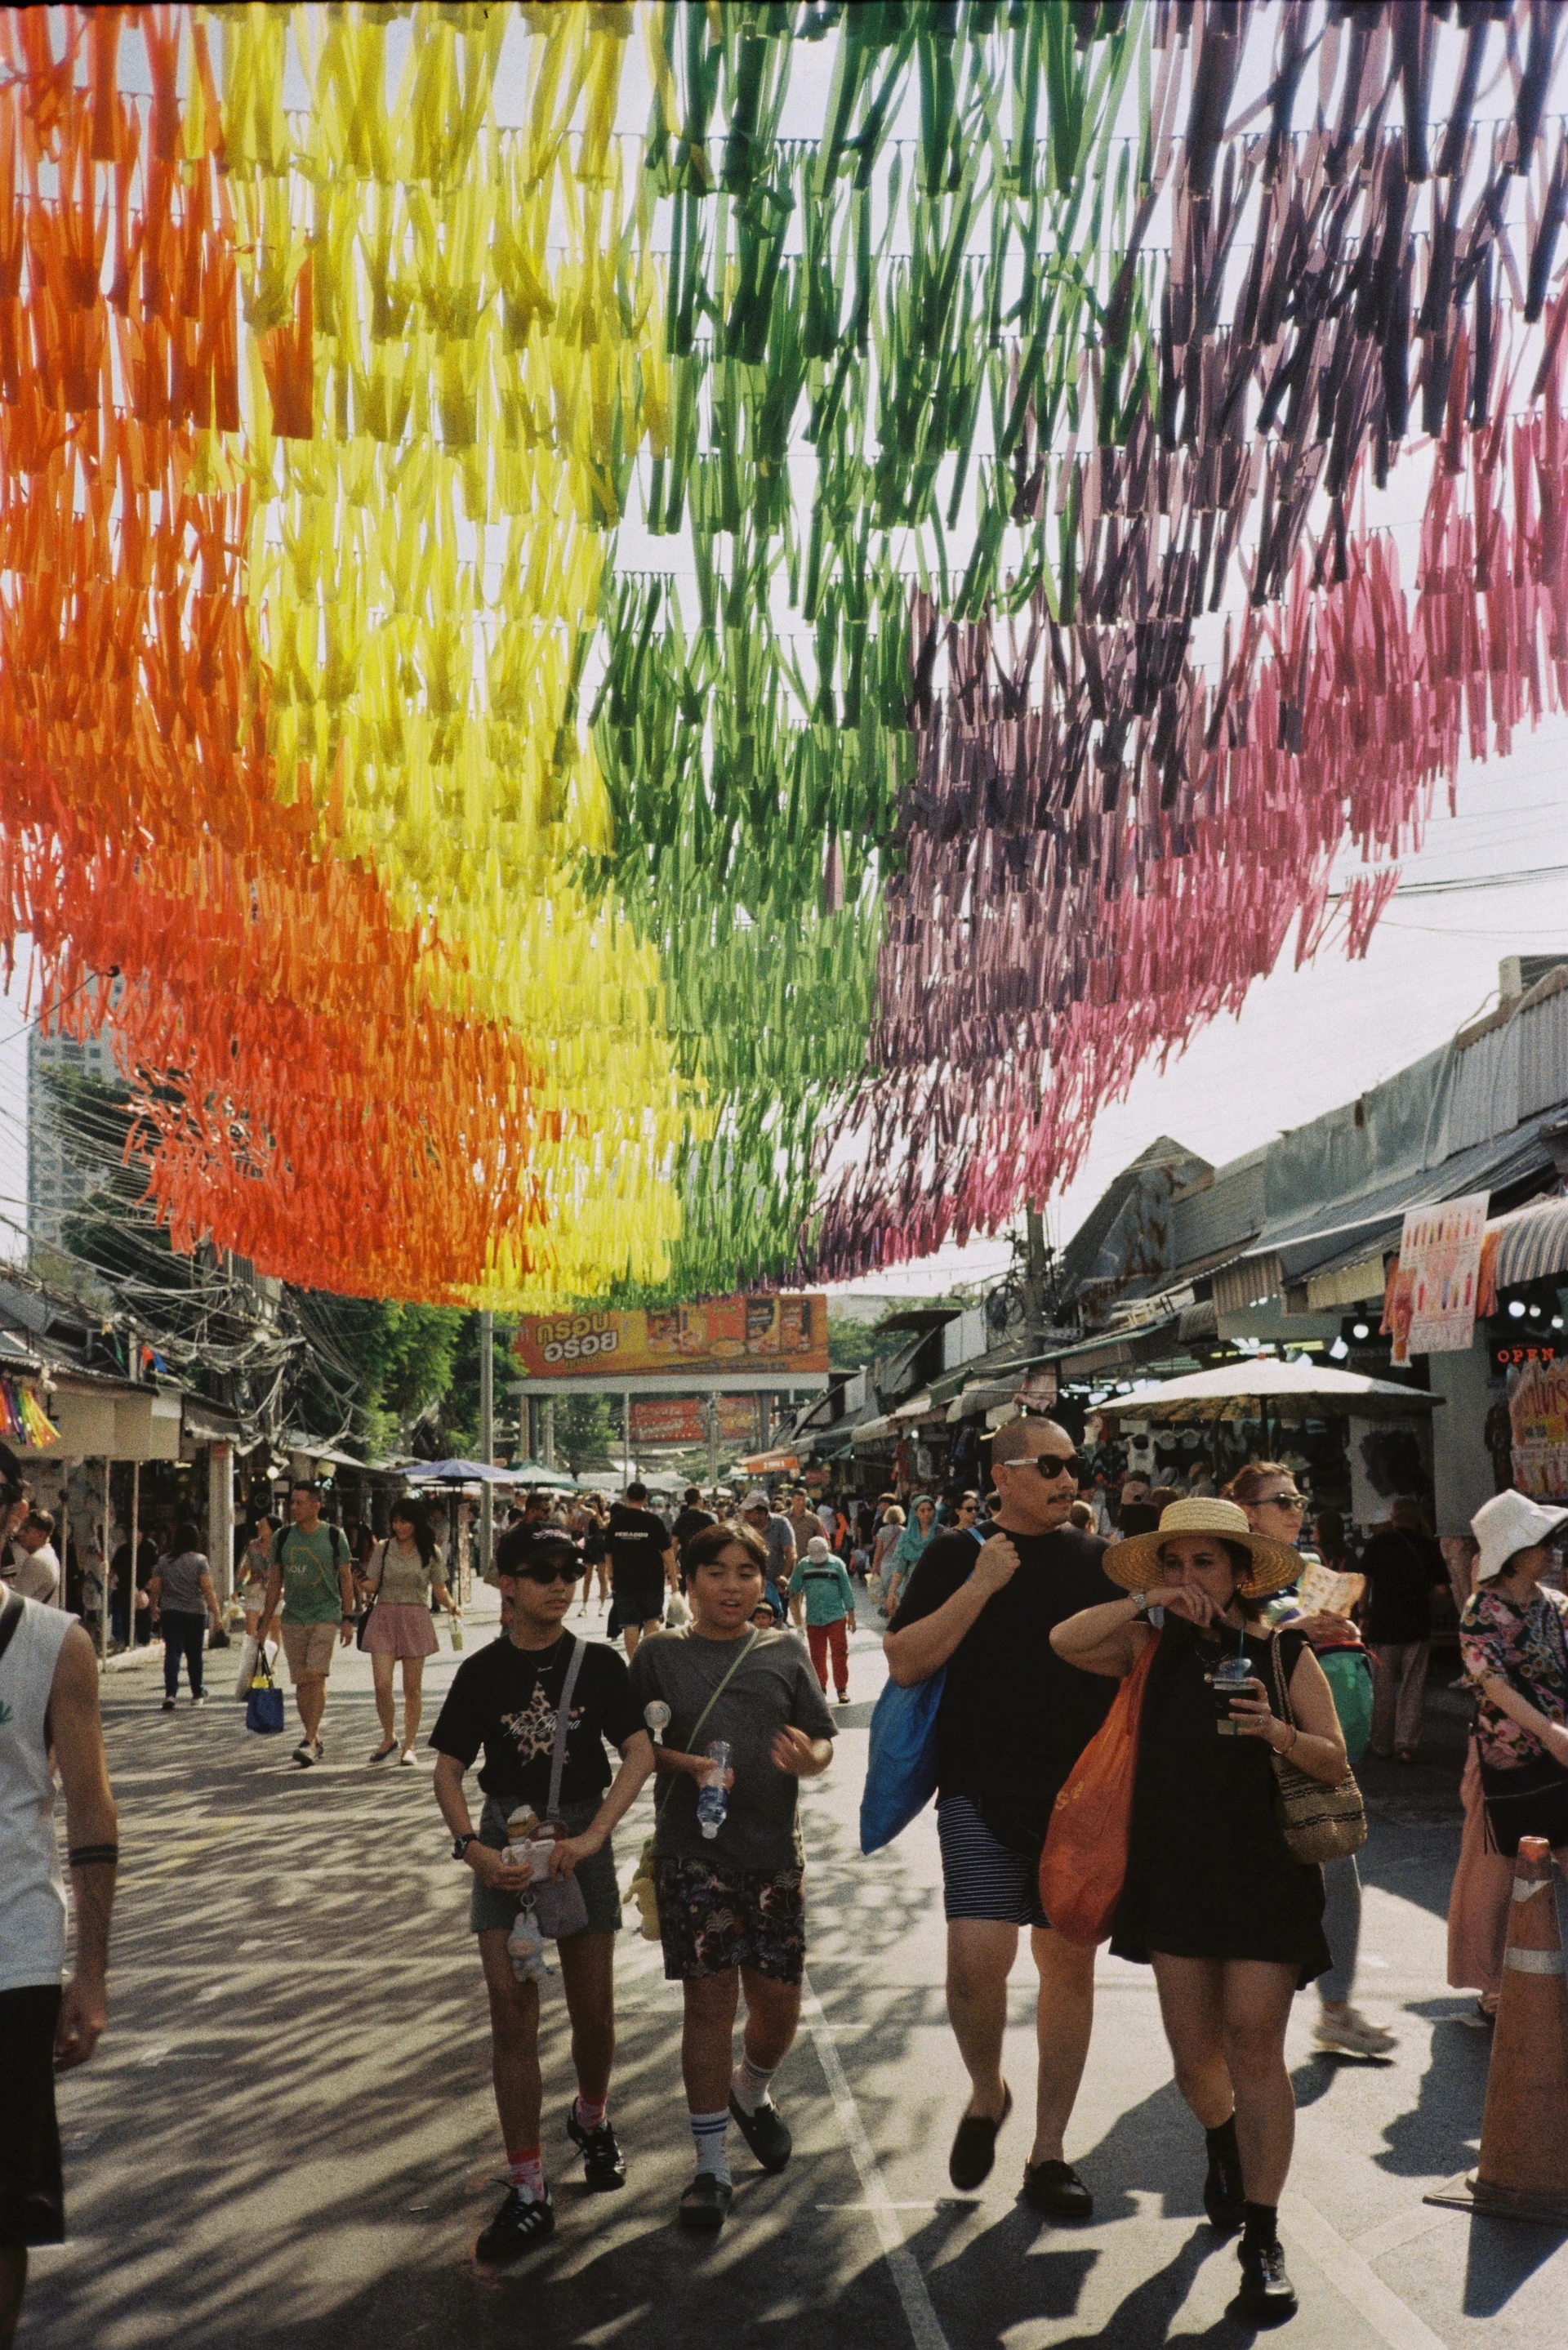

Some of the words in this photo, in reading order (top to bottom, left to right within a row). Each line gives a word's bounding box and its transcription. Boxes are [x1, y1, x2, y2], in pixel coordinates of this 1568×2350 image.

[537, 1313, 610, 1345] กรอบ
[544, 1331, 618, 1362] อร่อย
[1497, 1349, 1554, 1362] OPEN
